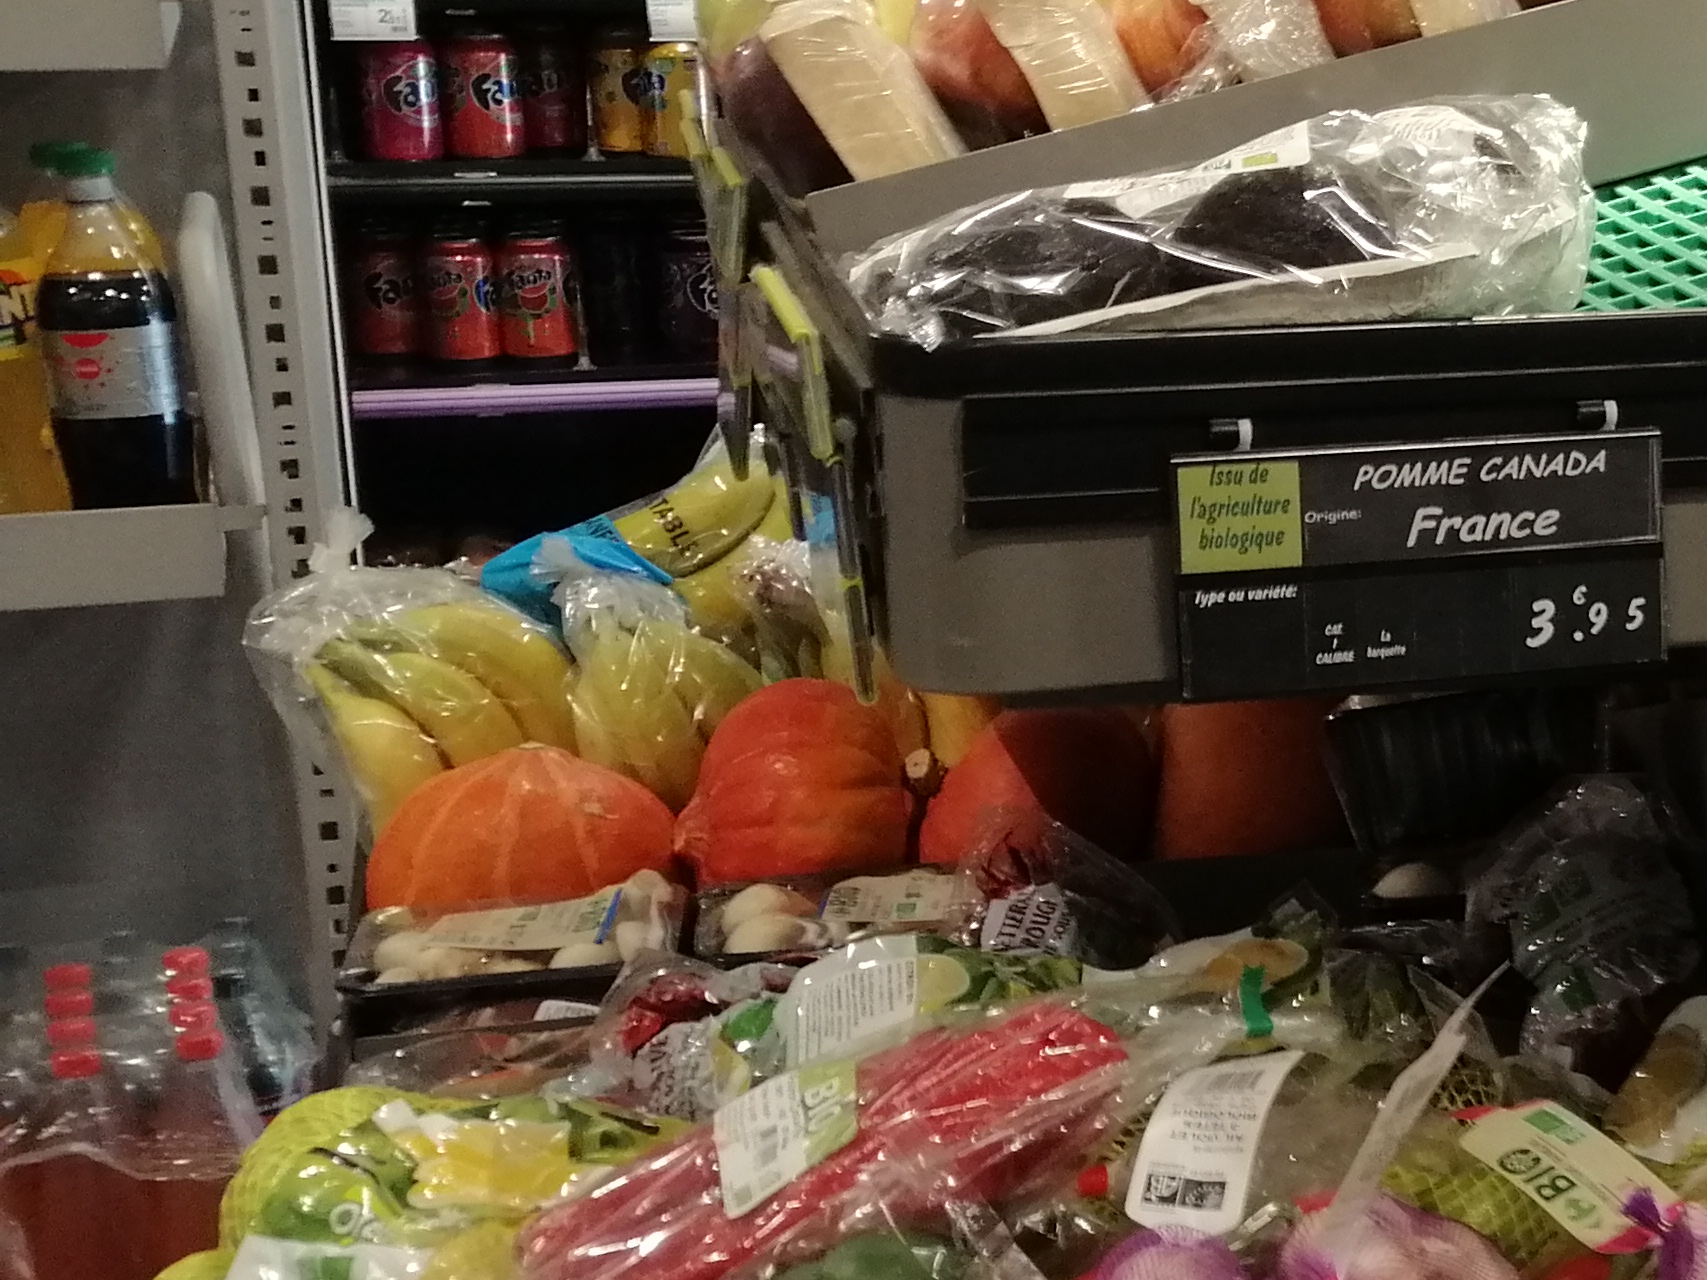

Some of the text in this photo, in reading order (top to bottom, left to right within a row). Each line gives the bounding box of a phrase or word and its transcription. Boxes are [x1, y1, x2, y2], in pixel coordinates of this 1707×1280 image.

[1208, 462, 1270, 488] Issu de
[1353, 449, 1608, 492] POMME CANADA
[1189, 492, 1291, 528] l'agriculture
[1198, 525, 1286, 555] biologique
[1304, 504, 1561, 549] Origine: France
[1194, 584, 1299, 609] Type ou variété:
[1315, 650, 1356, 666] CALIBRE
